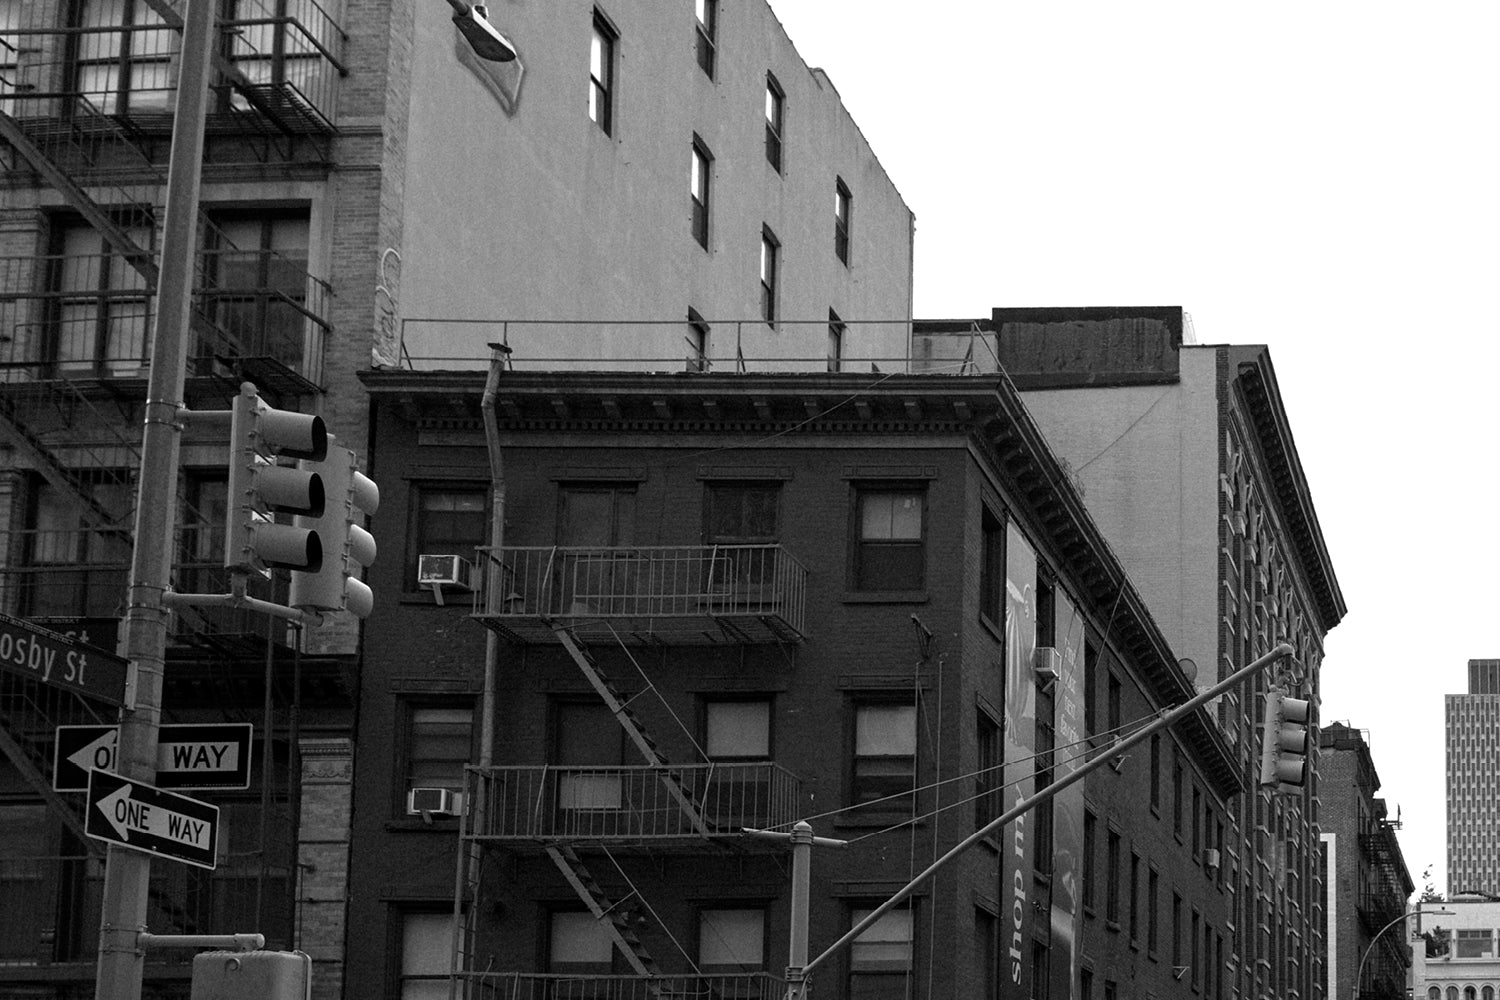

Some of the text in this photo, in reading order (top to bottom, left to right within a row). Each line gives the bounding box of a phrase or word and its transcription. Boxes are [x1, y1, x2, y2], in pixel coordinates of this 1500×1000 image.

[64, 650, 88, 686] St
[173, 745, 229, 769] WAY
[115, 798, 204, 845] ONE WAY
[1009, 868, 1026, 985] shop
